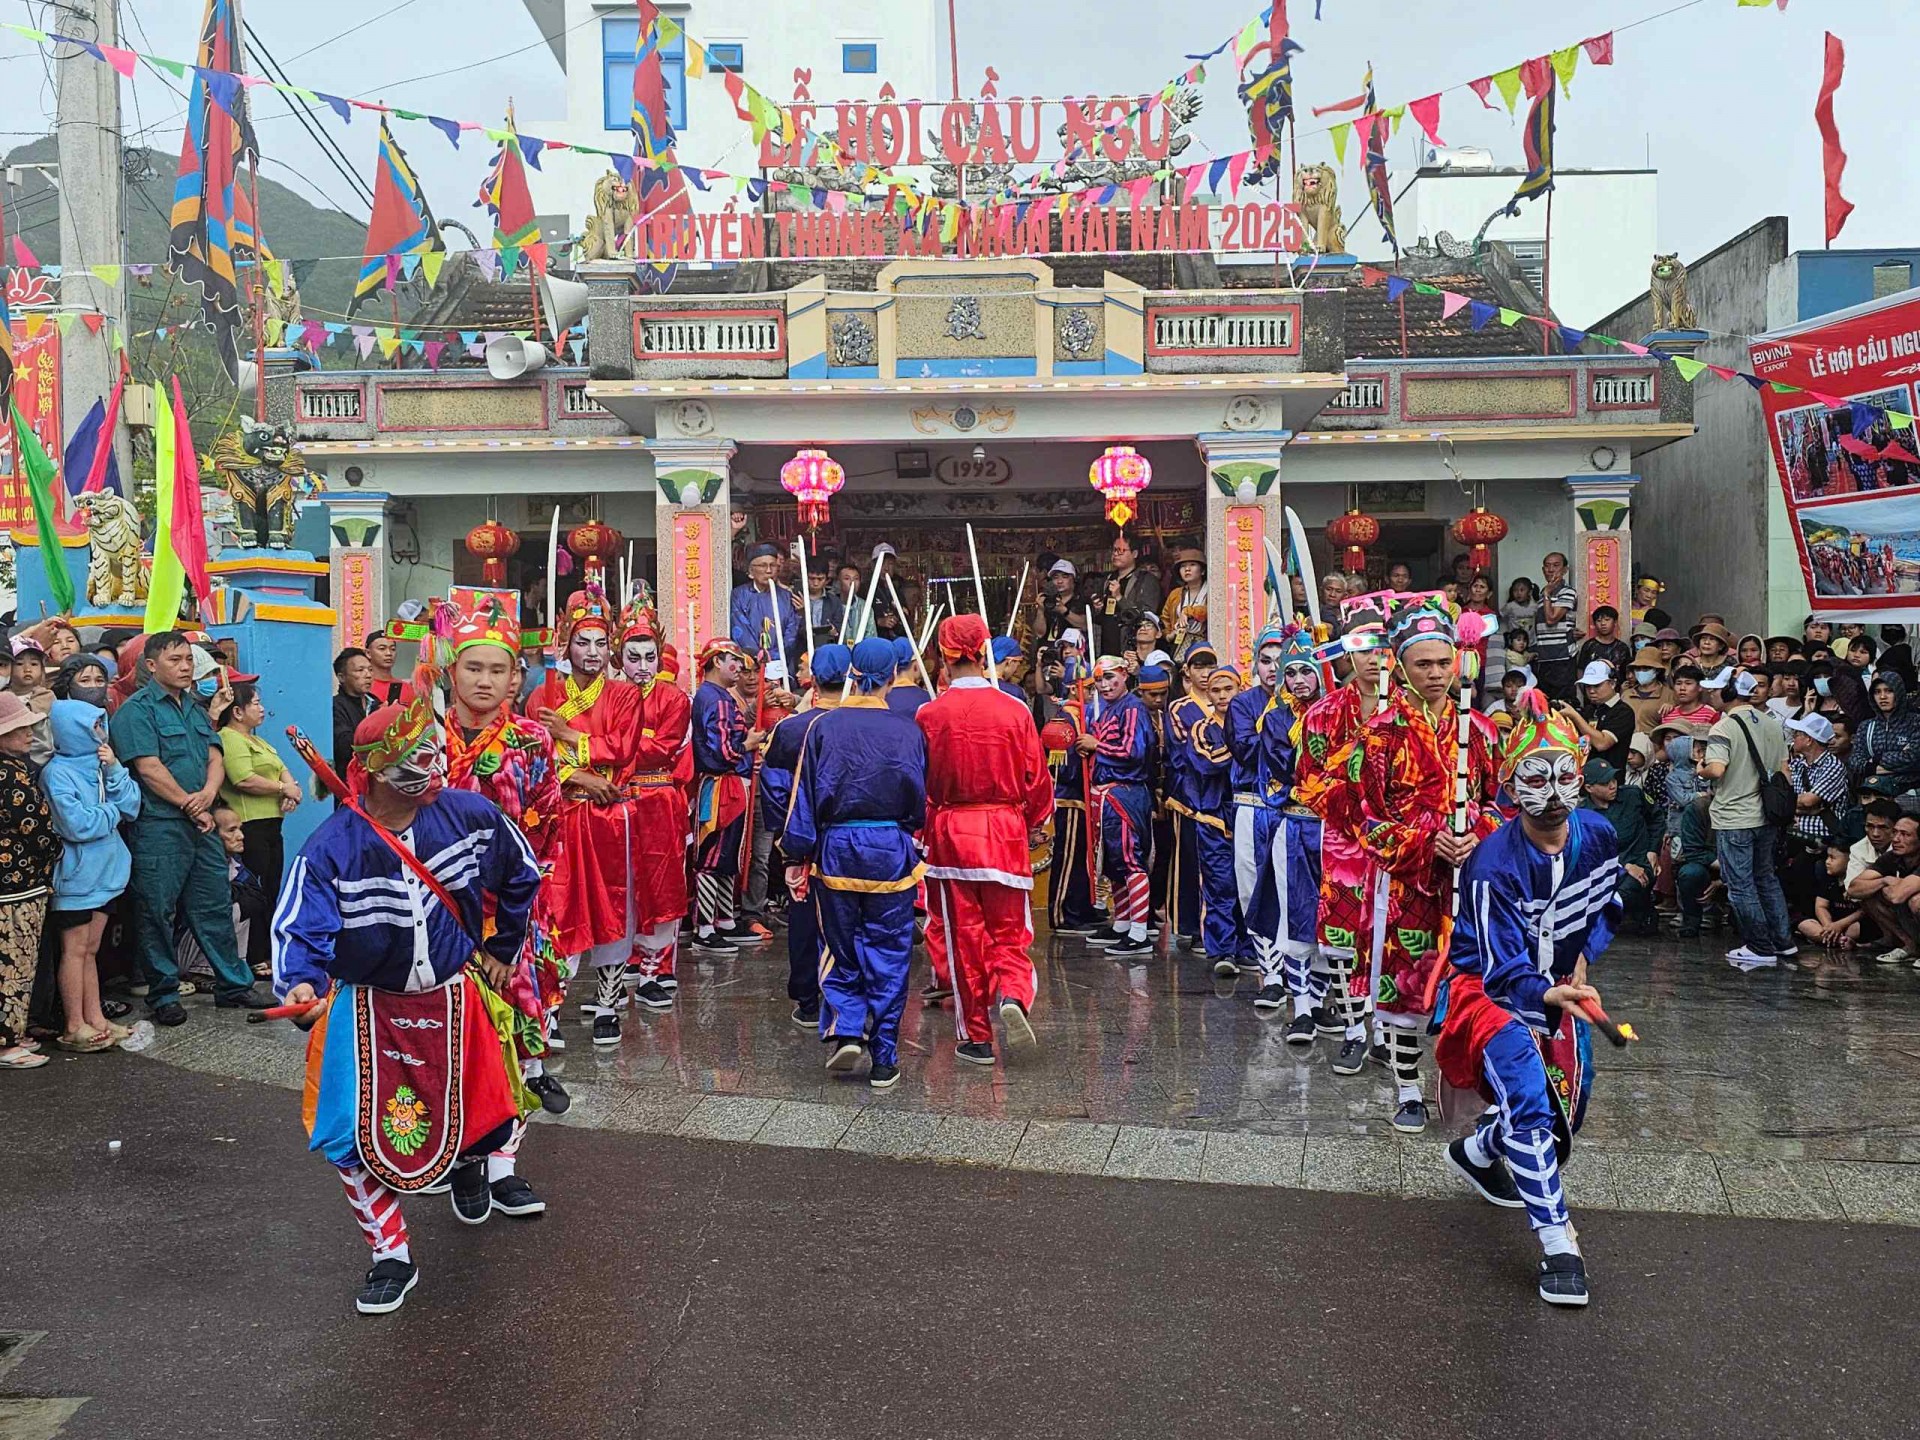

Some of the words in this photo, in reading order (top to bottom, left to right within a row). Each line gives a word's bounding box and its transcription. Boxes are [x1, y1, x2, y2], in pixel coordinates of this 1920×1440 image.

[940, 66, 1044, 164] CẦU
[1222, 202, 1302, 252] 2025
[1752, 344, 1792, 365] BIVINA
[1763, 361, 1788, 373] EXPORT
[1808, 347, 1827, 378] LỄ
[1828, 345, 1854, 375] HỘI
[1857, 334, 1888, 367] CẦU
[952, 460, 997, 478] 1992
